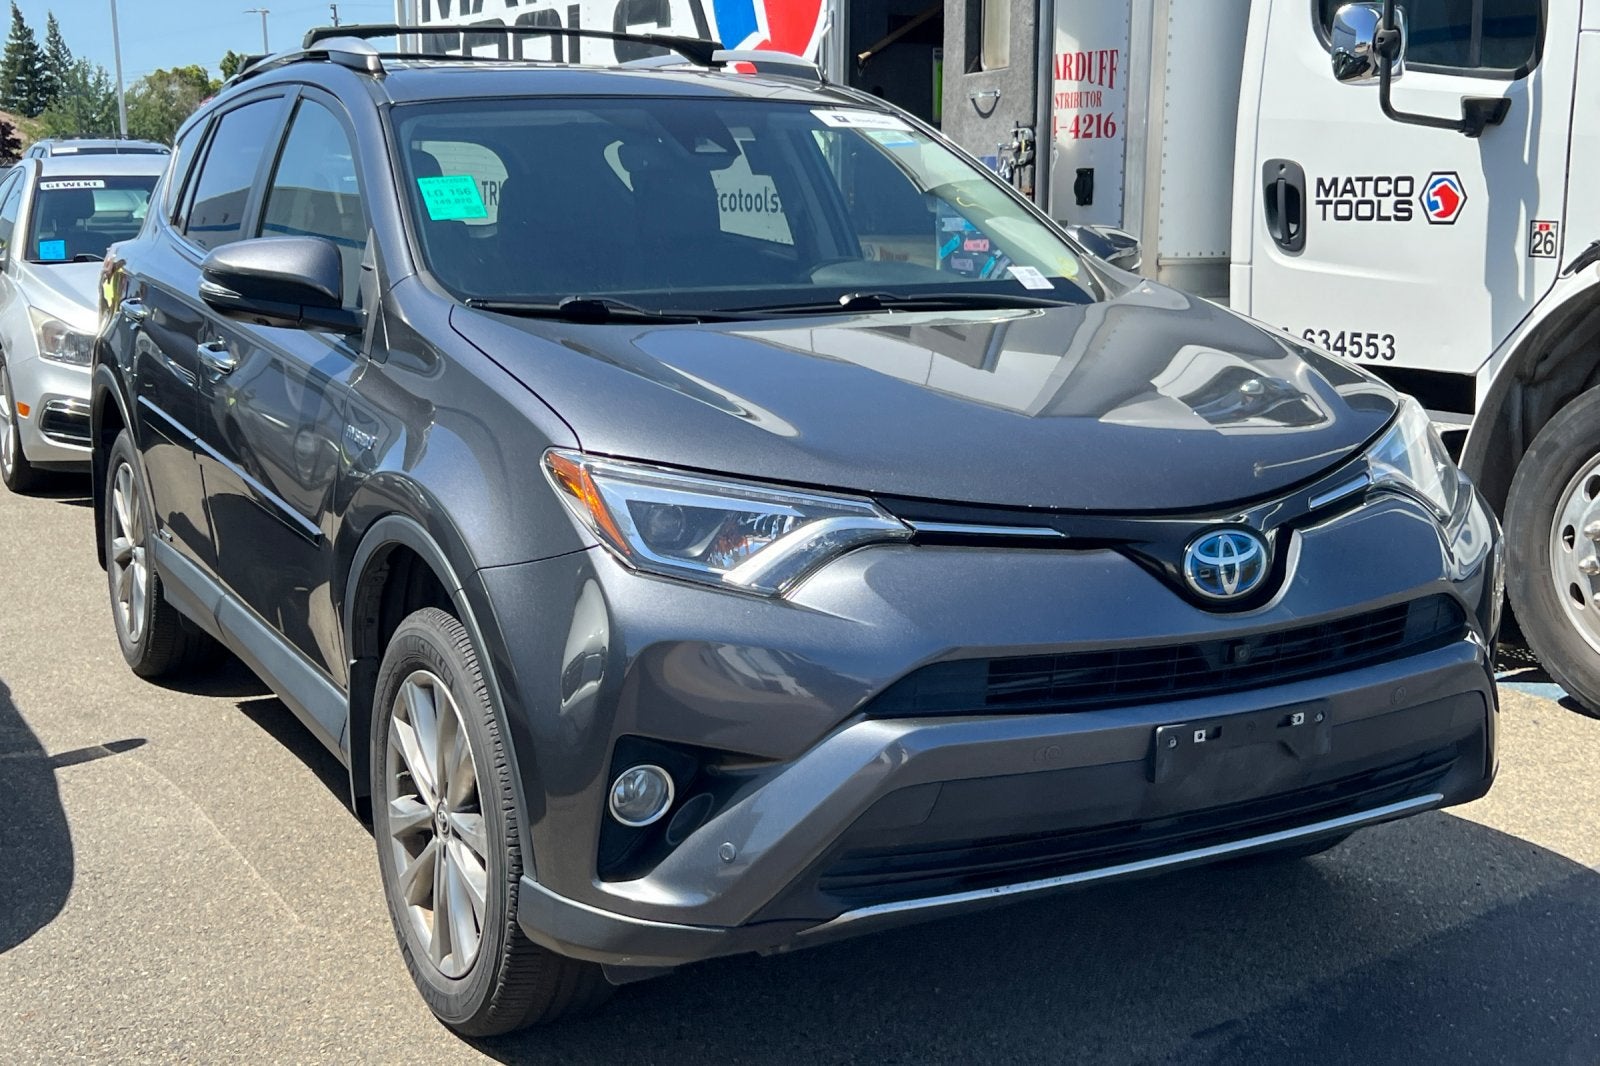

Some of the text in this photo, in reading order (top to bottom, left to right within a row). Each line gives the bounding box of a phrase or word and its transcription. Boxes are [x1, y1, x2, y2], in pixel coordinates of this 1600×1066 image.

[1315, 175, 1415, 199] MATCO
[1315, 199, 1414, 222] TOOLS
[1531, 230, 1555, 255] 26
